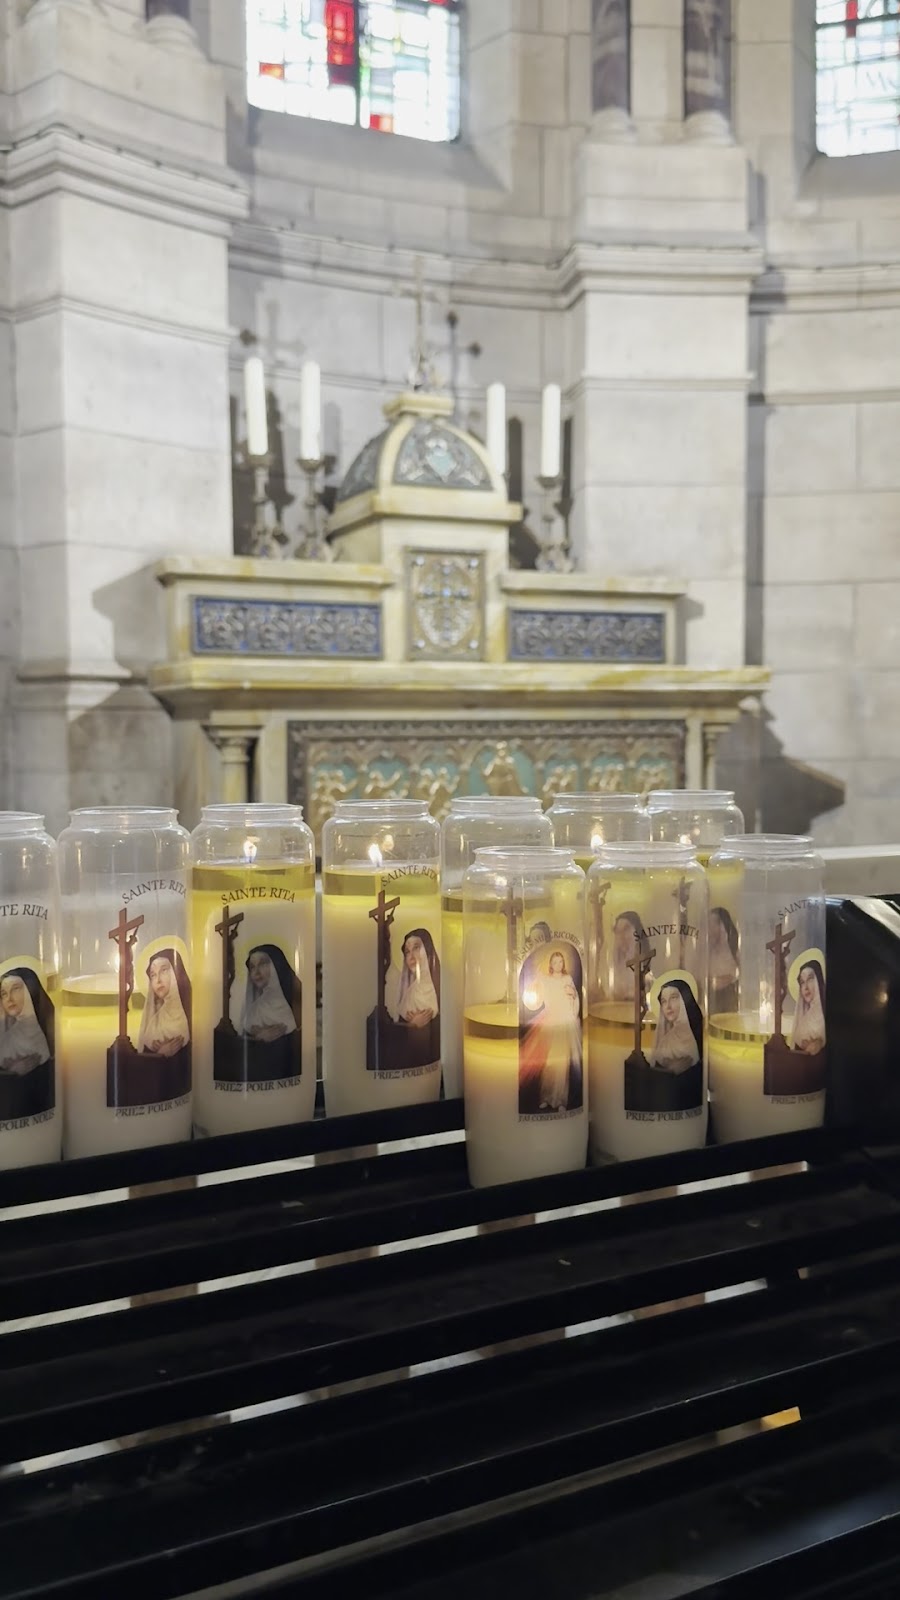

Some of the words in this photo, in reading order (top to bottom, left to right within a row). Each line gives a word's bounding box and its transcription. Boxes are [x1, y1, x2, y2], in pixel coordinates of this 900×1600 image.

[381, 864, 419, 887] SAINTE
[121, 879, 167, 904] SAINTE
[168, 879, 187, 899] RITA
[221, 886, 267, 905] SAINTE
[269, 887, 296, 903] RITA
[22, 903, 49, 920] RITA
[633, 924, 677, 942] SAINTE
[679, 924, 700, 940] RITA
[373, 1071, 400, 1080] PRIEZ
[214, 1081, 243, 1092] PRIEZ
[246, 1081, 275, 1093] POUR
[277, 1077, 302, 1090] NOUS
[115, 1106, 145, 1117] PRIEZ
[147, 1101, 173, 1115] POUR
[625, 1111, 655, 1122] PRIEZ
[656, 1111, 684, 1122] POUR
[0, 1119, 30, 1131] POUR
